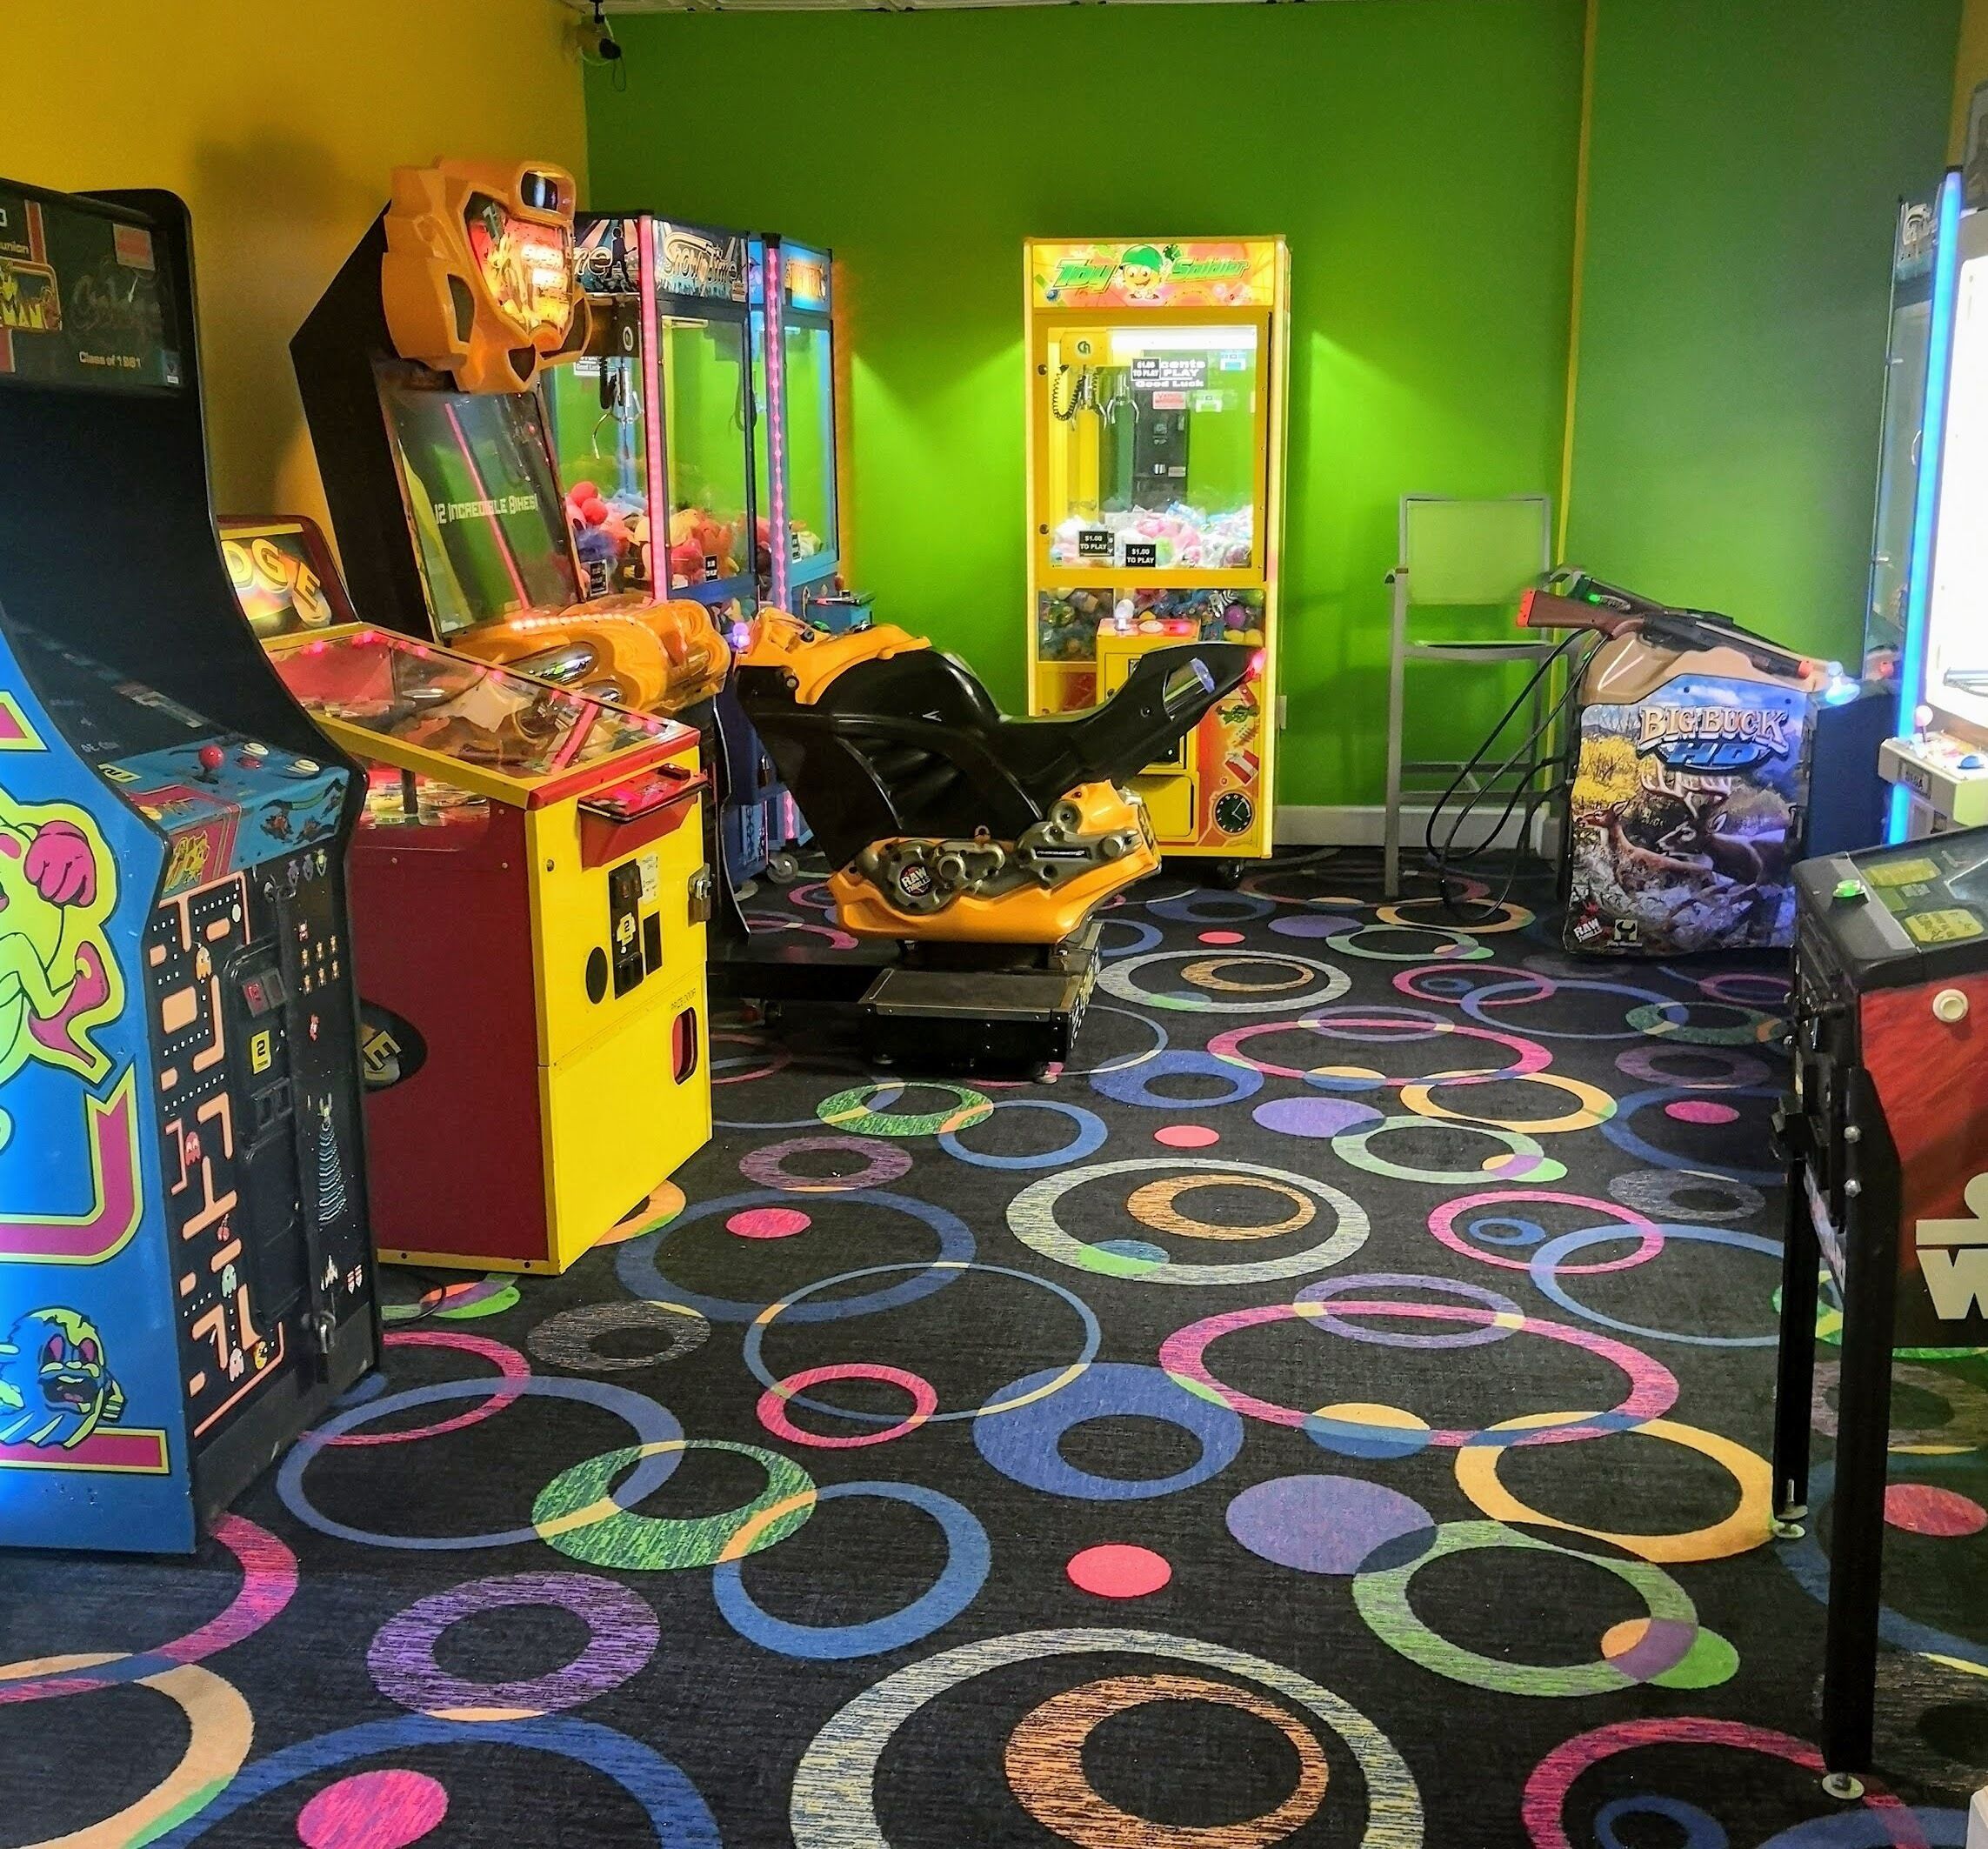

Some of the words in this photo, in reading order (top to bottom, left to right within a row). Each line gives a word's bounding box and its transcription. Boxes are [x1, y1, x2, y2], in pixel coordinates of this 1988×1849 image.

[1053, 259, 1119, 293] Toy
[1172, 379, 1204, 388] Luck
[1638, 705, 1696, 752] BIG
[1699, 706, 1790, 754] BUCK
[1666, 742, 1761, 764] HD
[901, 866, 927, 888] RAW
[624, 920, 630, 932] 2
[1573, 918, 1600, 939] RAW
[257, 1039, 266, 1057] 2
